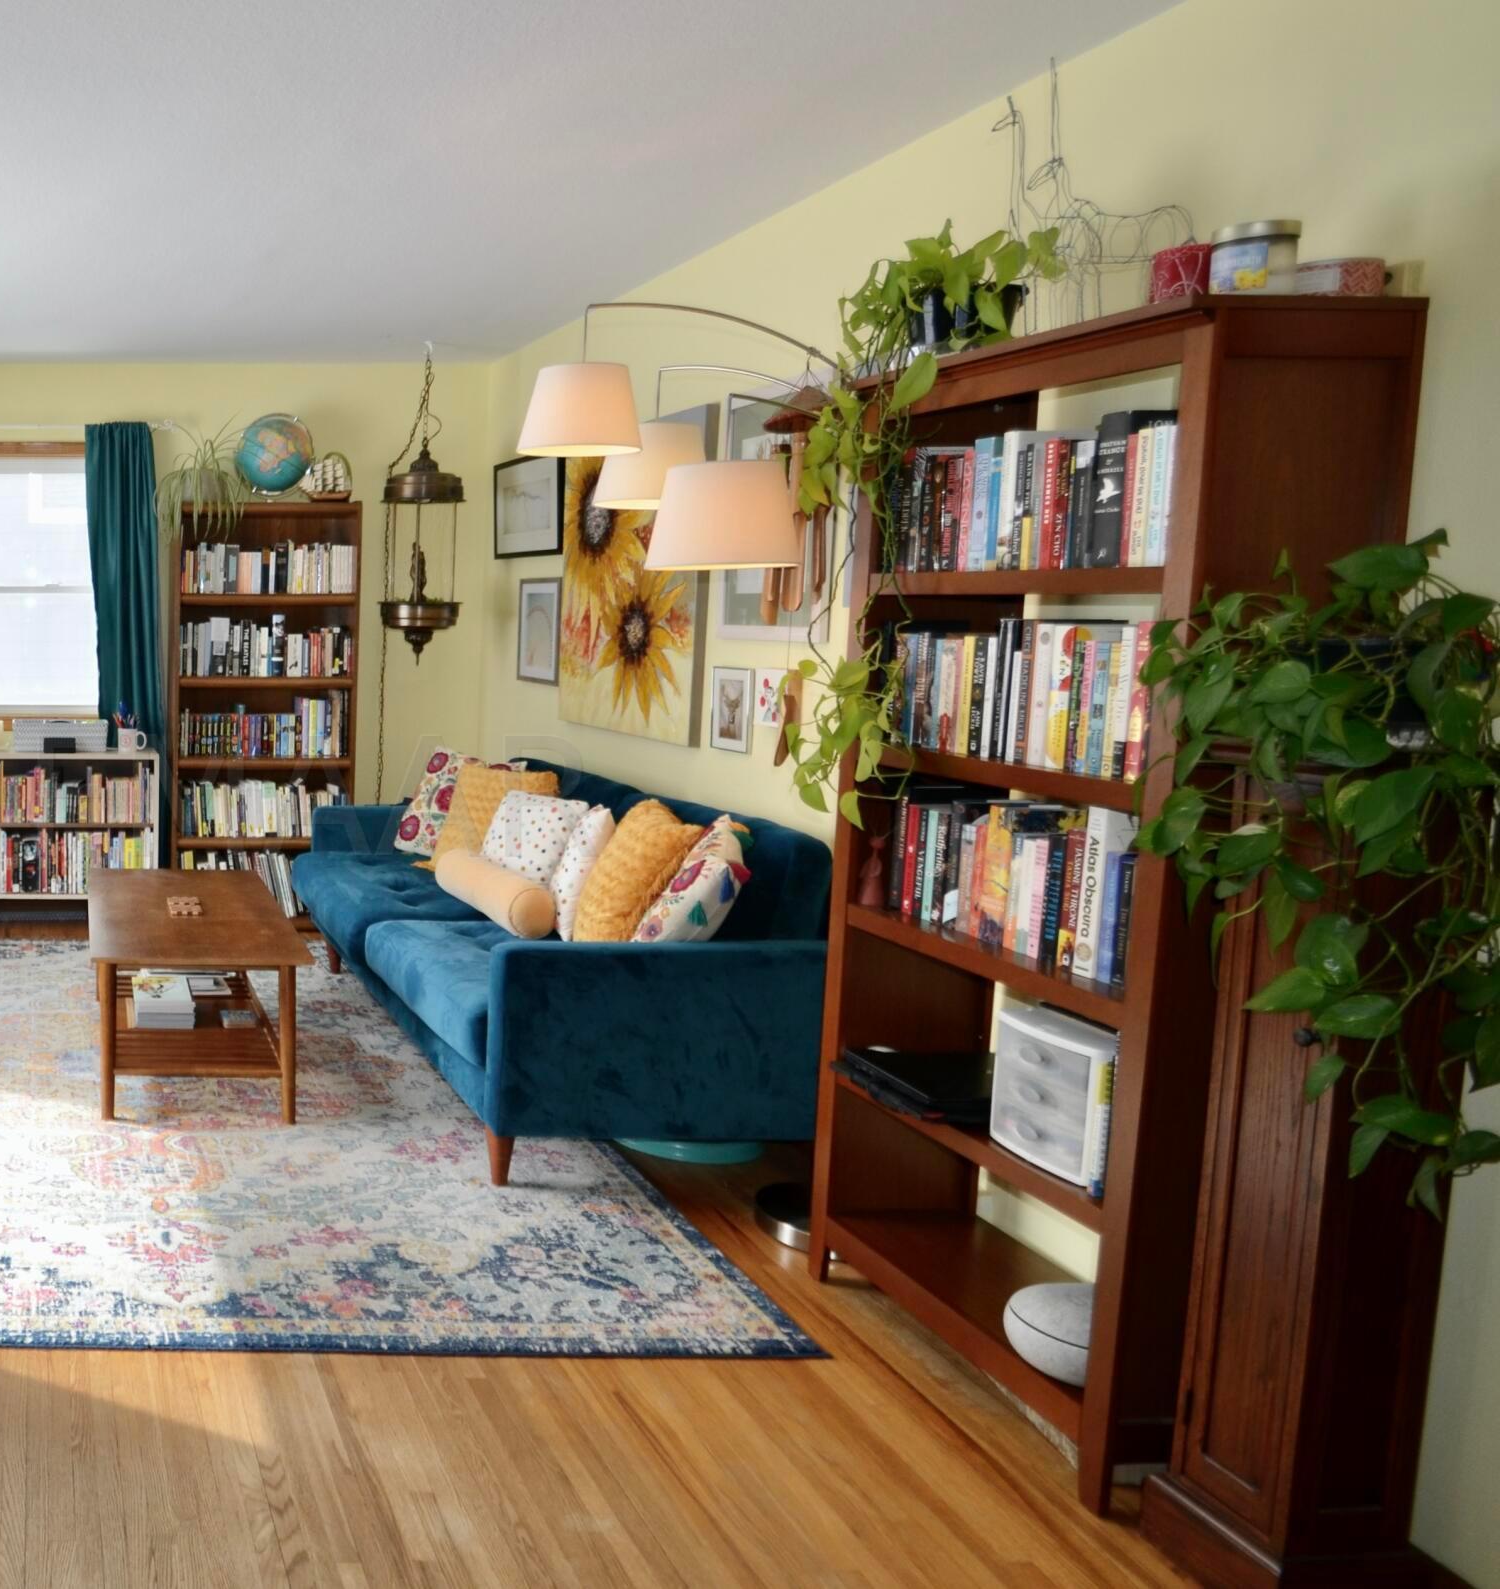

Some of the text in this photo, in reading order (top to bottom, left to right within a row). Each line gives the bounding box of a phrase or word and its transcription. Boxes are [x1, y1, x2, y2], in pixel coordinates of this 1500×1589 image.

[1011, 521, 1021, 555] Kindred
[1053, 513, 1063, 556] ZEN CHO
[915, 677, 925, 705] DUNE
[978, 657, 986, 684] RAVEN
[1017, 626, 1032, 740] CIRCE MADELINE MILLER
[1081, 644, 1093, 708] OUTLAWED
[900, 807, 908, 843] INVISIBLE
[934, 825, 947, 871] Katherine
[915, 850, 925, 900] VENGEFUL
[1068, 848, 1083, 929] JASMINE THRONE
[1080, 836, 1100, 938] Atlas Obscura
